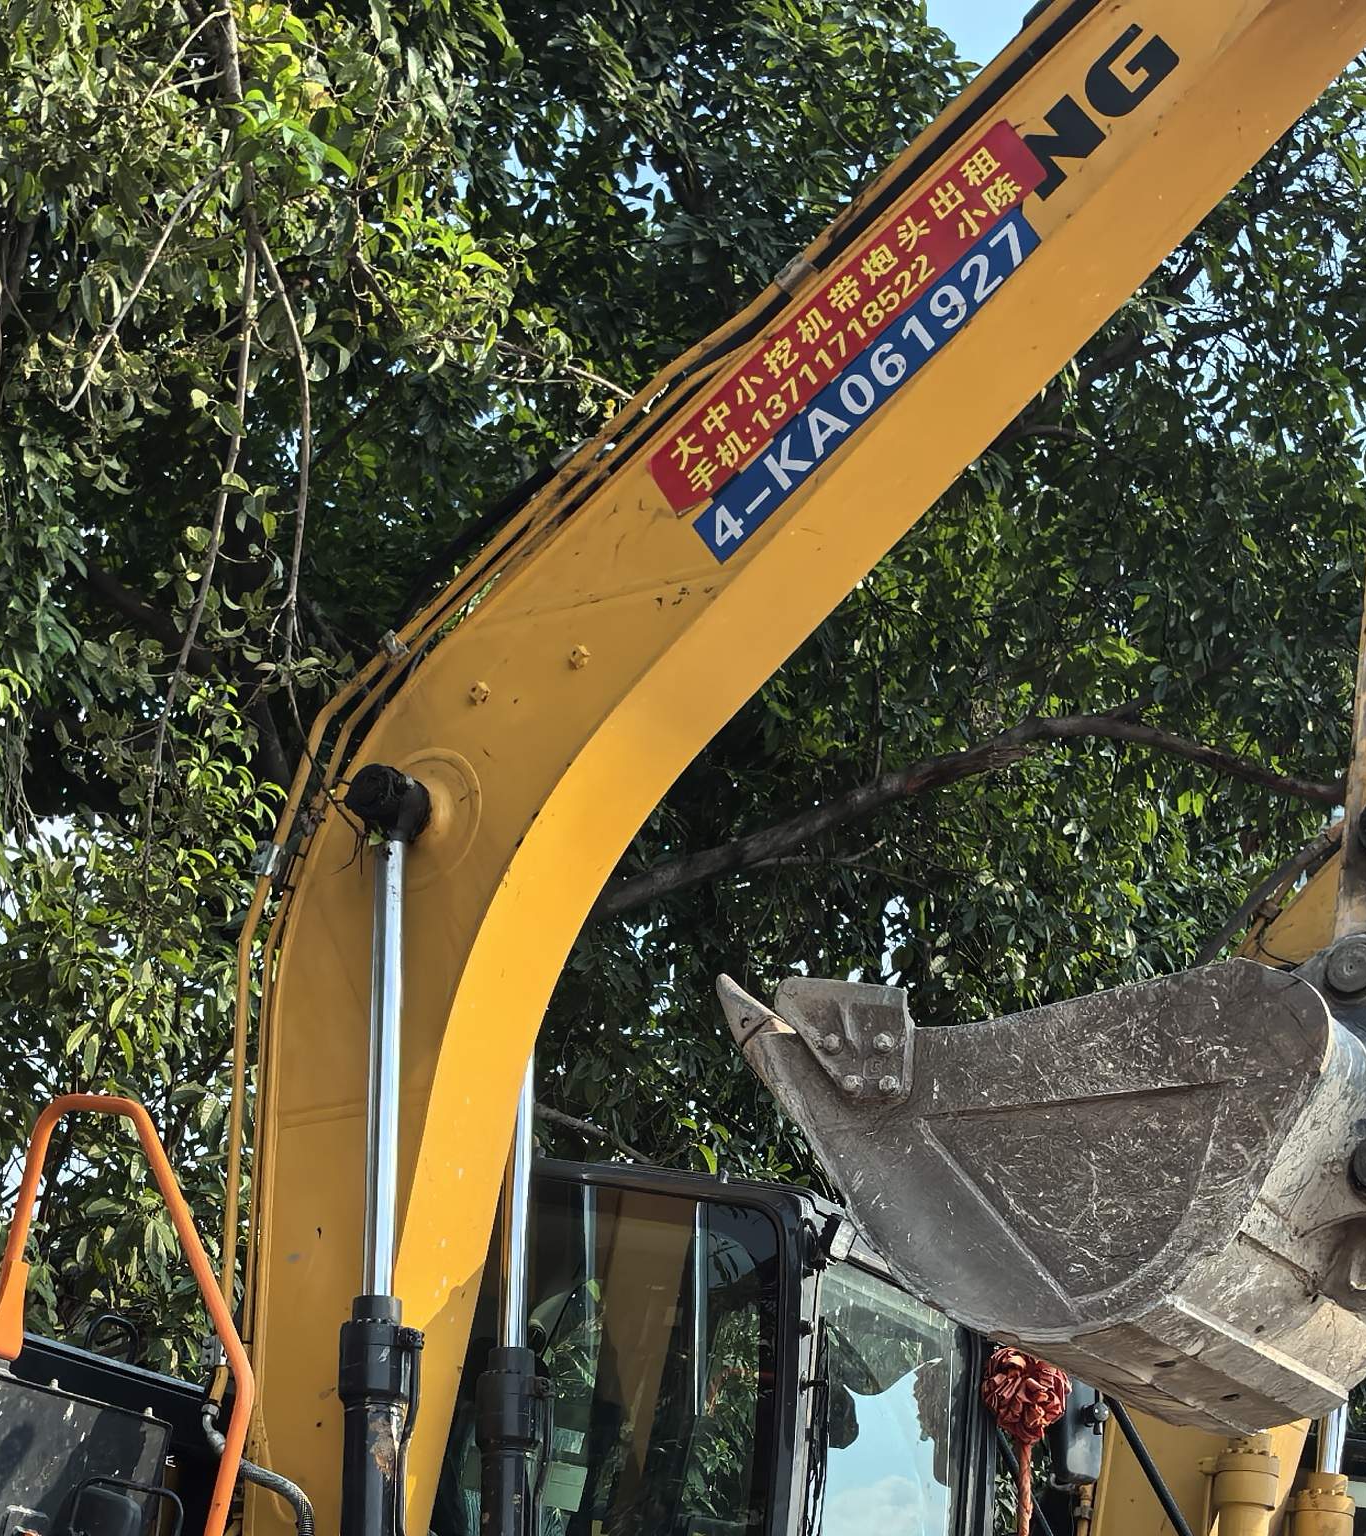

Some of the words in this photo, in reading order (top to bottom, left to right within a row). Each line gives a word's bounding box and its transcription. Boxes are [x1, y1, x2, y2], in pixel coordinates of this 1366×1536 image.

[669, 147, 1002, 471] 大中小挖机带炮头出租
[957, 172, 1023, 241] 小陈
[713, 220, 1025, 547] 4-KA061927
